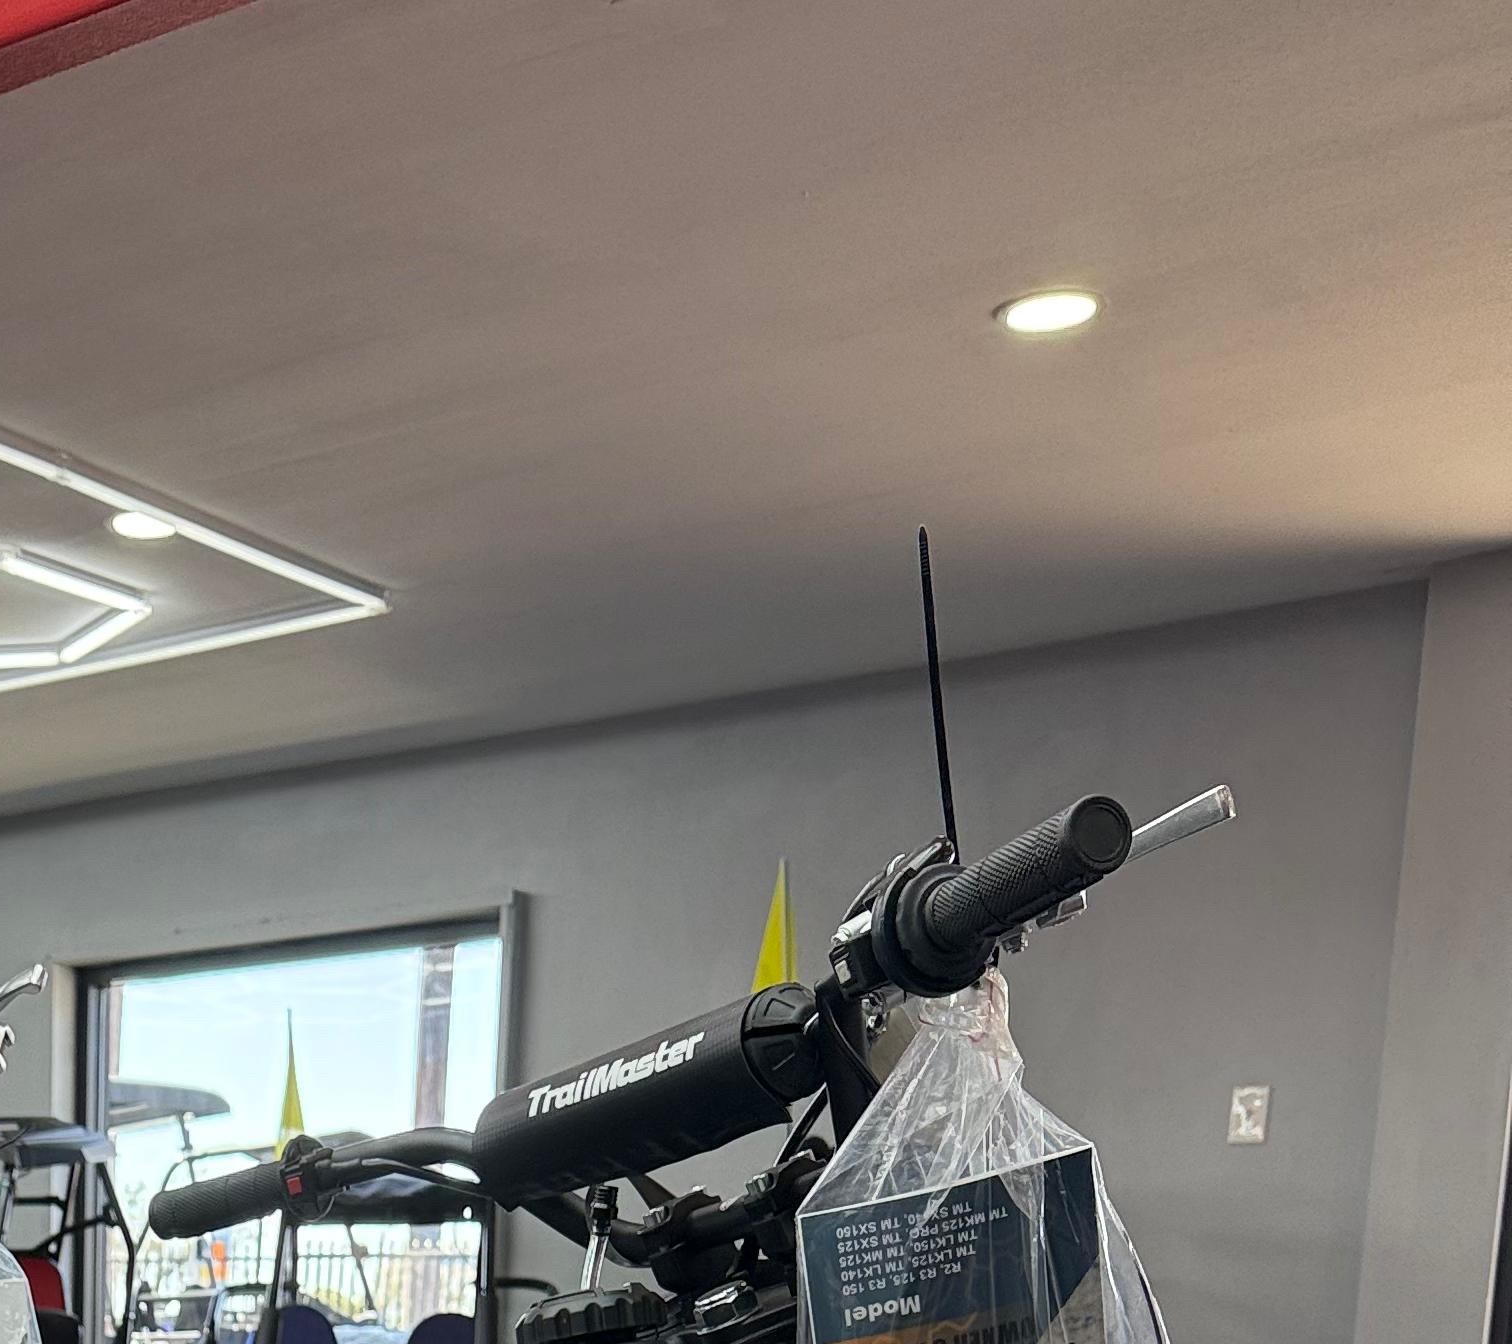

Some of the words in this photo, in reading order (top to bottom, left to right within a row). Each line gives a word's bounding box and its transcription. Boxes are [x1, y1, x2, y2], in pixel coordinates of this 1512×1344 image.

[528, 1032, 705, 1118] TrailMaster
[989, 1206, 1009, 1221] TM
[881, 1217, 901, 1231] TM
[881, 1231, 903, 1245] TM
[957, 1228, 978, 1242] TM
[886, 1245, 905, 1258] TM
[956, 1243, 977, 1258] TM
[885, 1261, 905, 1274] TM
[844, 1294, 921, 1328] Model
